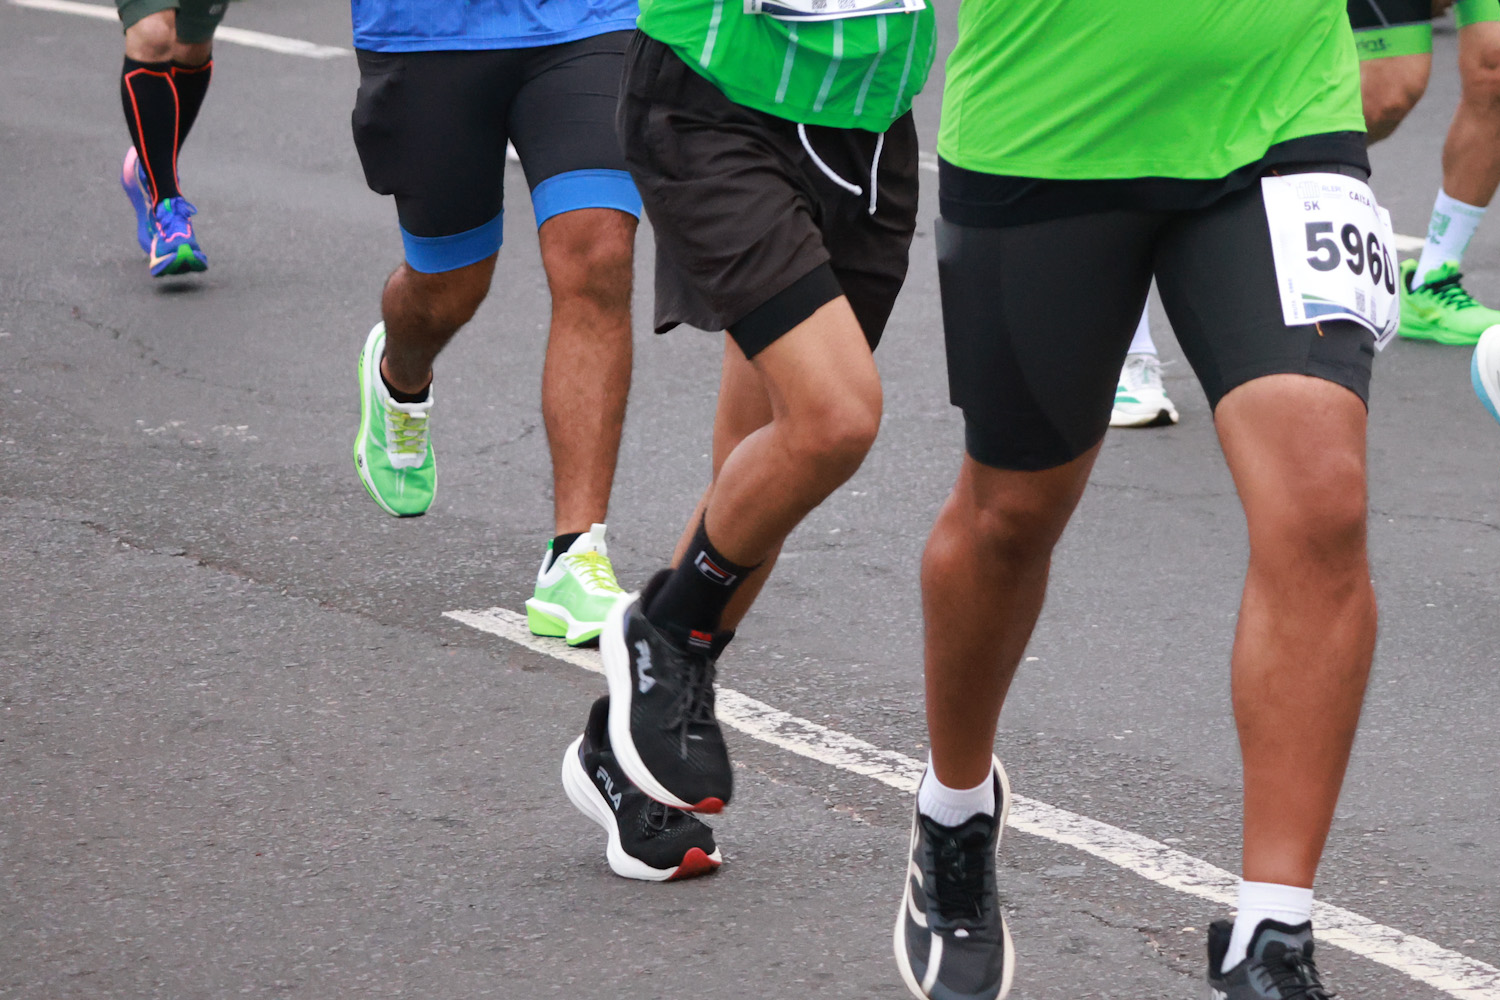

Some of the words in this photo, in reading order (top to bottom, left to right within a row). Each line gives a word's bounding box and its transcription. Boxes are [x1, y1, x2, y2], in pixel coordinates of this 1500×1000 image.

[1304, 201, 1321, 211] 5K
[634, 639, 656, 694] FILA
[597, 766, 622, 811] FILA
